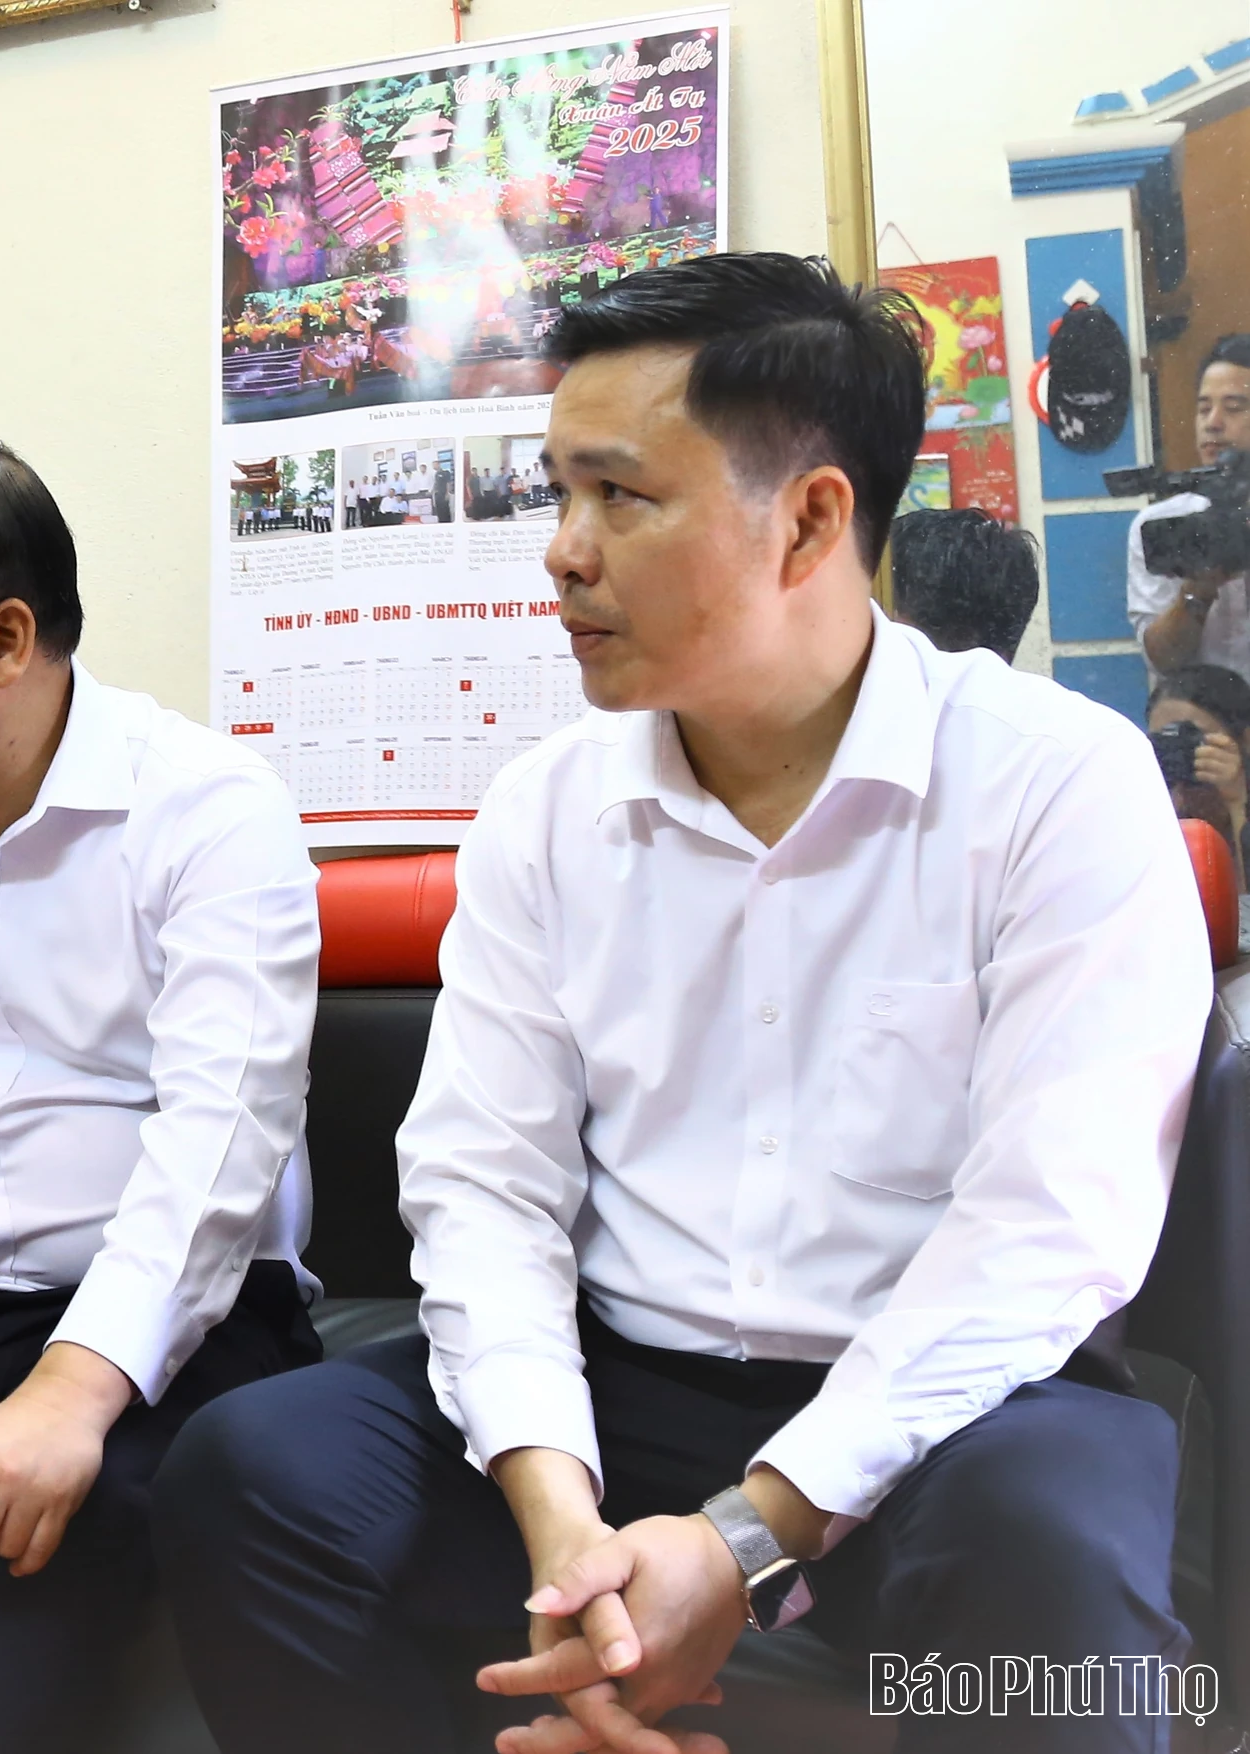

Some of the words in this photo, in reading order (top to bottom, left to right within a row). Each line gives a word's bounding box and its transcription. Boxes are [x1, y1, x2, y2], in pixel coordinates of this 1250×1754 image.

[588, 51, 657, 85] Năm
[658, 40, 713, 76] Mới
[558, 103, 625, 126] Xuân
[628, 86, 664, 115] Ất
[603, 115, 703, 159] 2025
[537, 401, 554, 410] 202
[324, 608, 359, 626] HĐND
[372, 604, 411, 622] UBND
[426, 602, 487, 620] UBMTTQ
[492, 599, 523, 621] VIỆT
[528, 600, 561, 617] NAM
